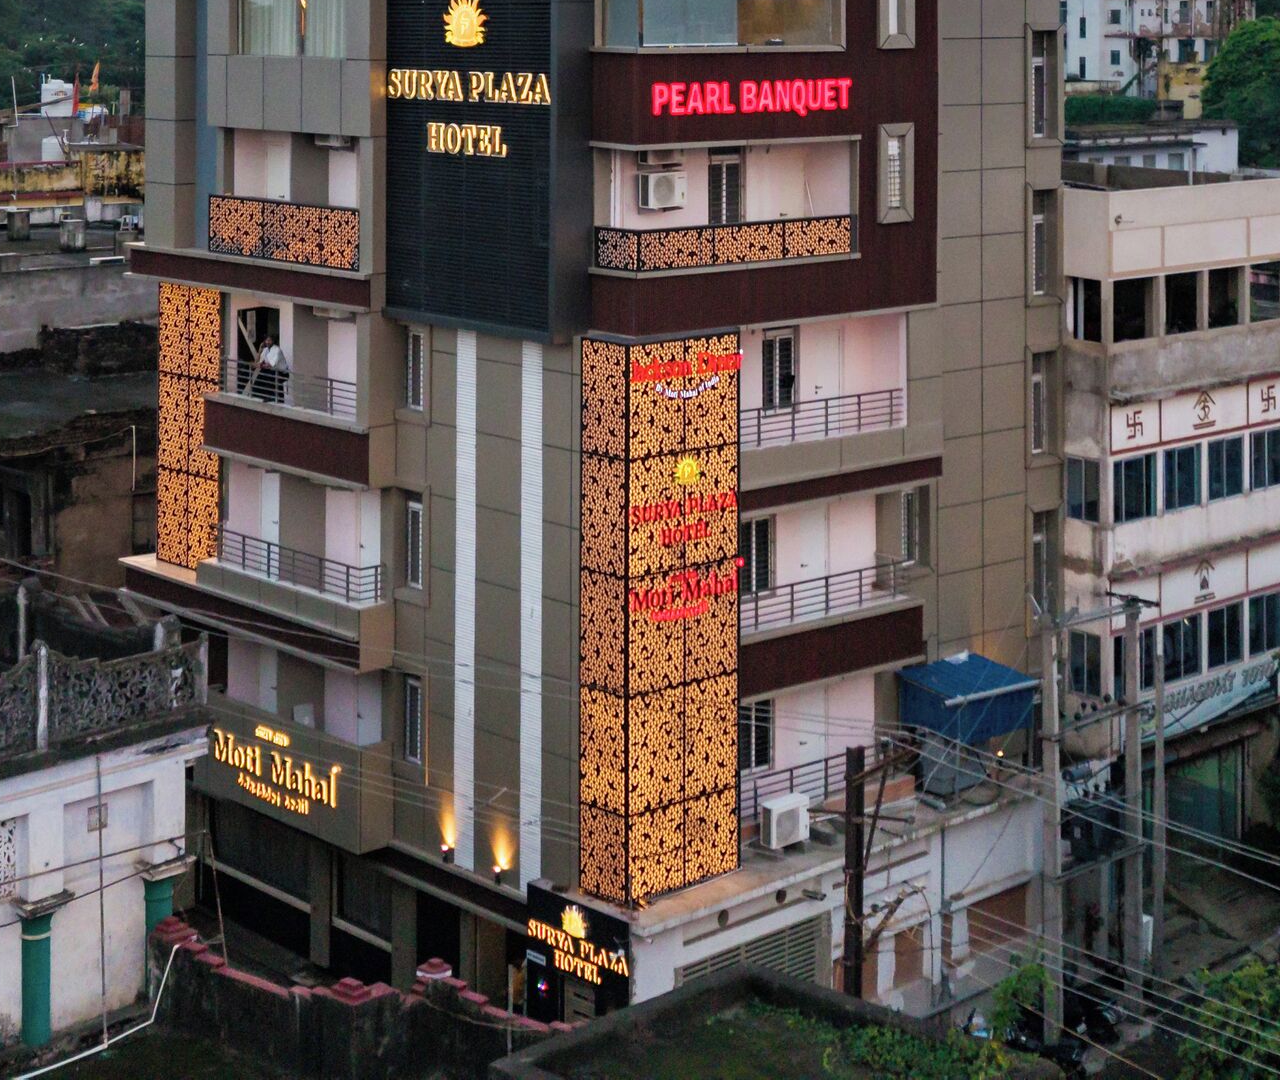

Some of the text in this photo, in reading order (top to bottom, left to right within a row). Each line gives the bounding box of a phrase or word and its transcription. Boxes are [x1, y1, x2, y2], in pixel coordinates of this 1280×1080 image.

[387, 69, 552, 105] SURYA PLAZA
[651, 77, 852, 117] PEARL BANQUET
[426, 122, 508, 157] HOTEL
[630, 351, 743, 383] Jackson Diner
[630, 489, 738, 524] SURYA PLAZA
[661, 521, 711, 545] HOTEL
[629, 584, 675, 613] Moti
[681, 569, 738, 602] Mahal
[213, 728, 262, 777] Moti
[270, 750, 337, 809] Mahal
[527, 918, 629, 978] SURYA PLAZA
[554, 949, 602, 985] HOTEL
